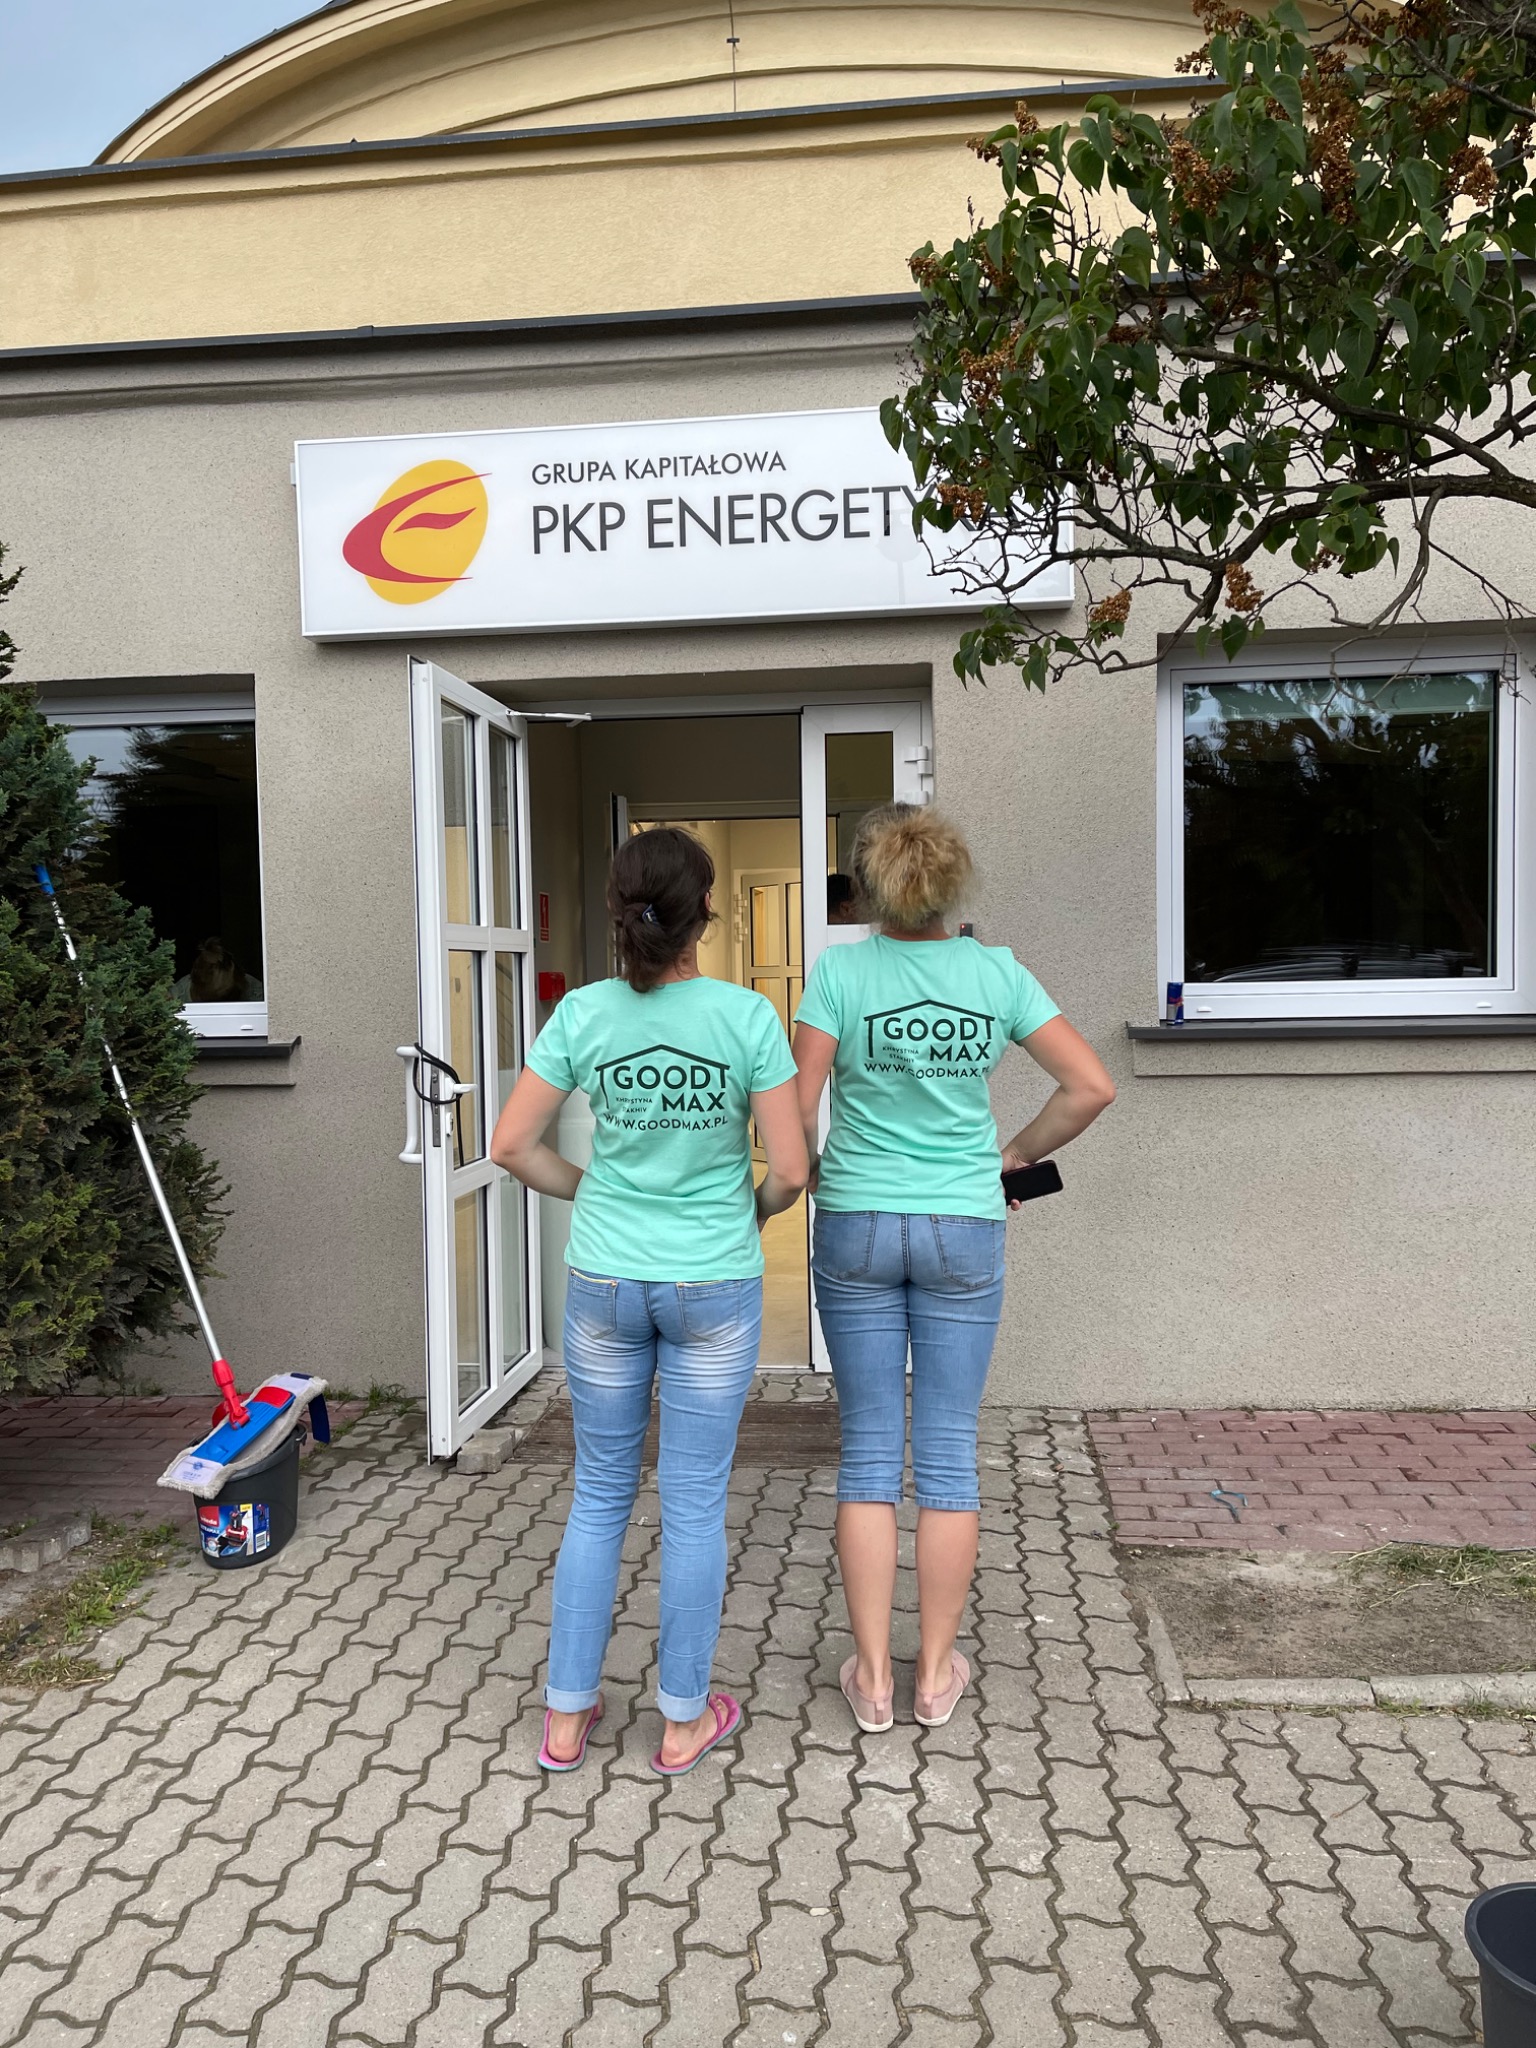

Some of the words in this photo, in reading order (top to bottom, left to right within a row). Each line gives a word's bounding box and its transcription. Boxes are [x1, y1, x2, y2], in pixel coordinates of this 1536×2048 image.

[532, 460, 616, 485] GRUPA
[625, 450, 787, 480] KAPITAŁOWA
[532, 501, 626, 554] PKP
[647, 485, 1023, 549] ENERGETY
[883, 1017, 978, 1042] GOOD
[929, 1041, 991, 1062] MAX
[613, 1065, 711, 1089] GOOD
[661, 1092, 726, 1112] MAX
[603, 1112, 728, 1131] WWW.GOODMAX.PL
